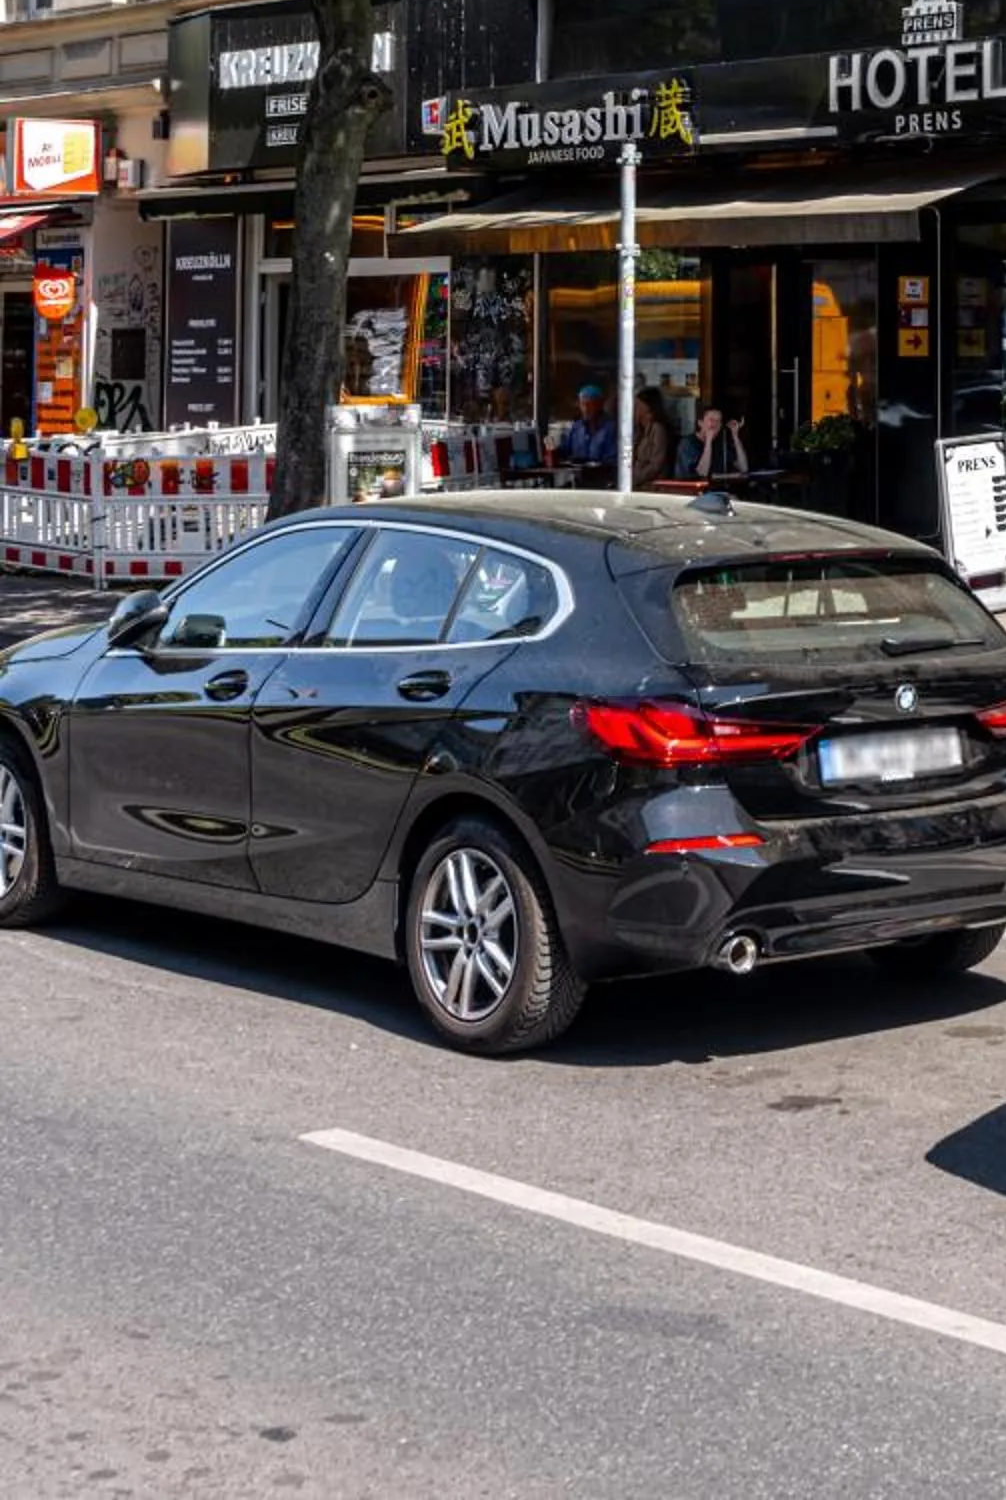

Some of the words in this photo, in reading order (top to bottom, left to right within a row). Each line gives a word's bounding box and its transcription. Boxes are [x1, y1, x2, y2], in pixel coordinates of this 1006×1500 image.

[903, 13, 954, 33] PRENS
[269, 97, 307, 114] FRISE
[479, 88, 646, 150] Musashi
[895, 109, 962, 133] PRENS
[527, 147, 575, 164] JAPANESE
[576, 146, 605, 161] FOOD
[957, 456, 997, 473] PRENS
